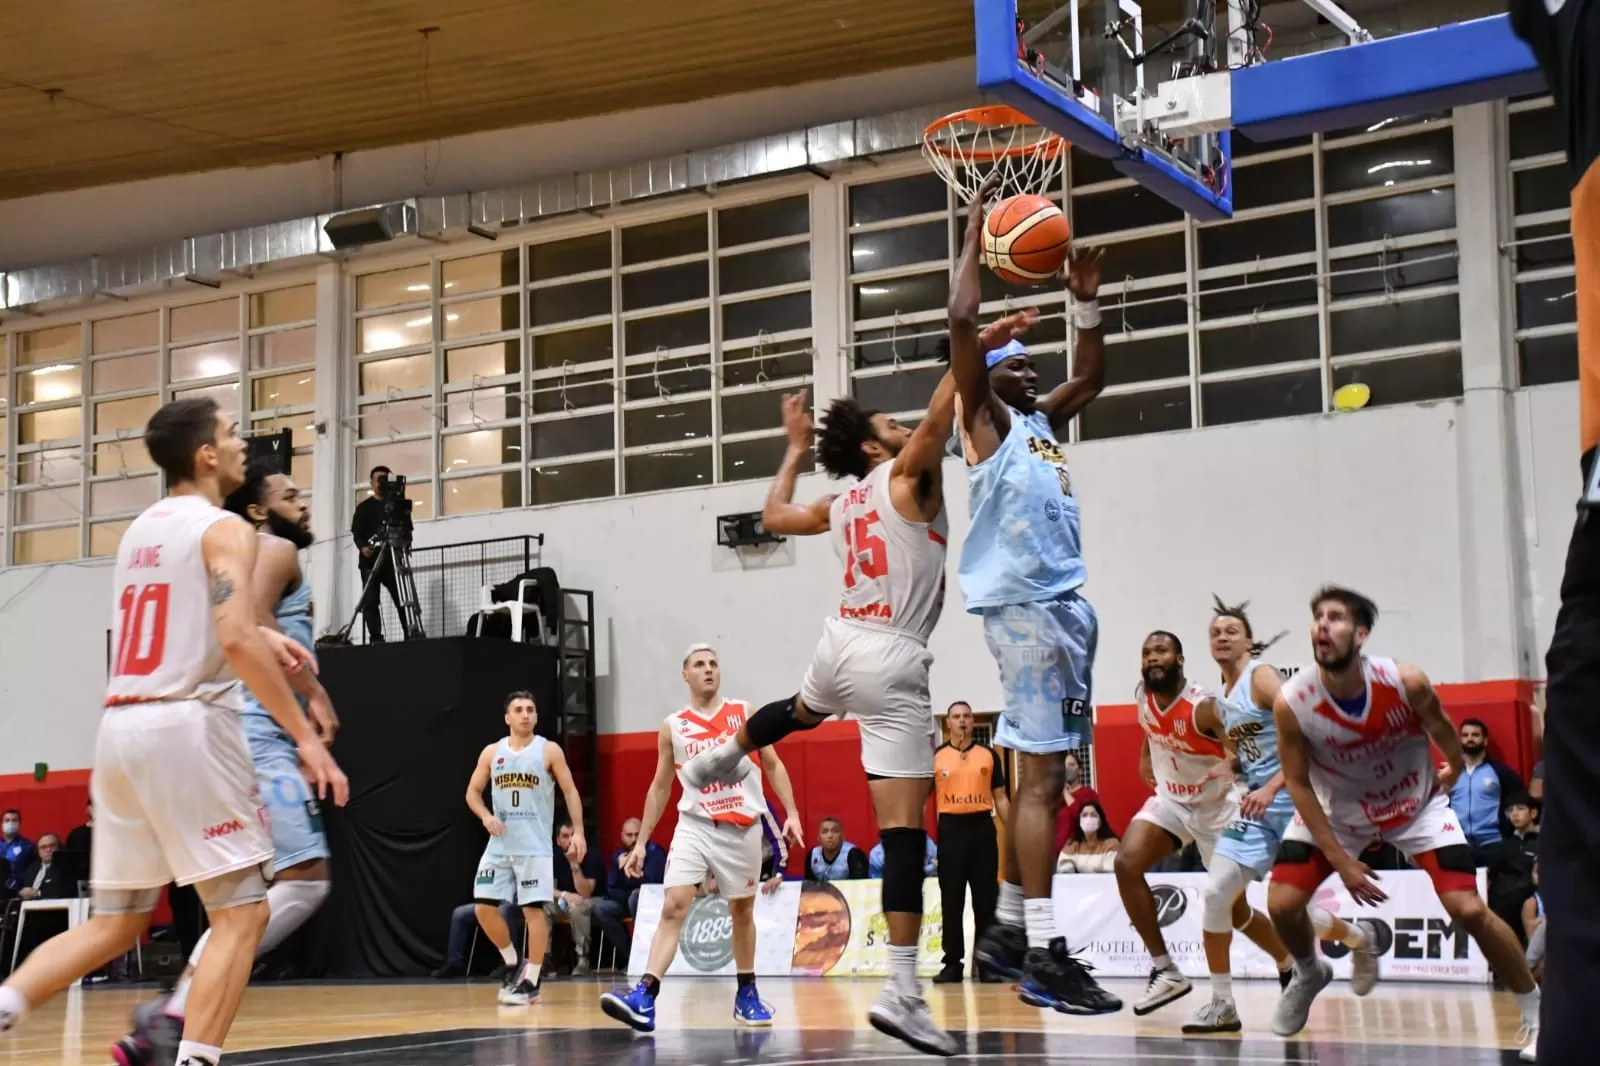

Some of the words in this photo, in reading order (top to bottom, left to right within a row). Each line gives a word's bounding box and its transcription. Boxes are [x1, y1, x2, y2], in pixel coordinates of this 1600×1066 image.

[844, 509, 889, 589] 15
[115, 583, 171, 676] 10
[495, 773, 540, 786] HISPANO
[512, 791, 520, 807] 0
[691, 916, 733, 943] 1885
[1090, 941, 1136, 953] HOTEL
